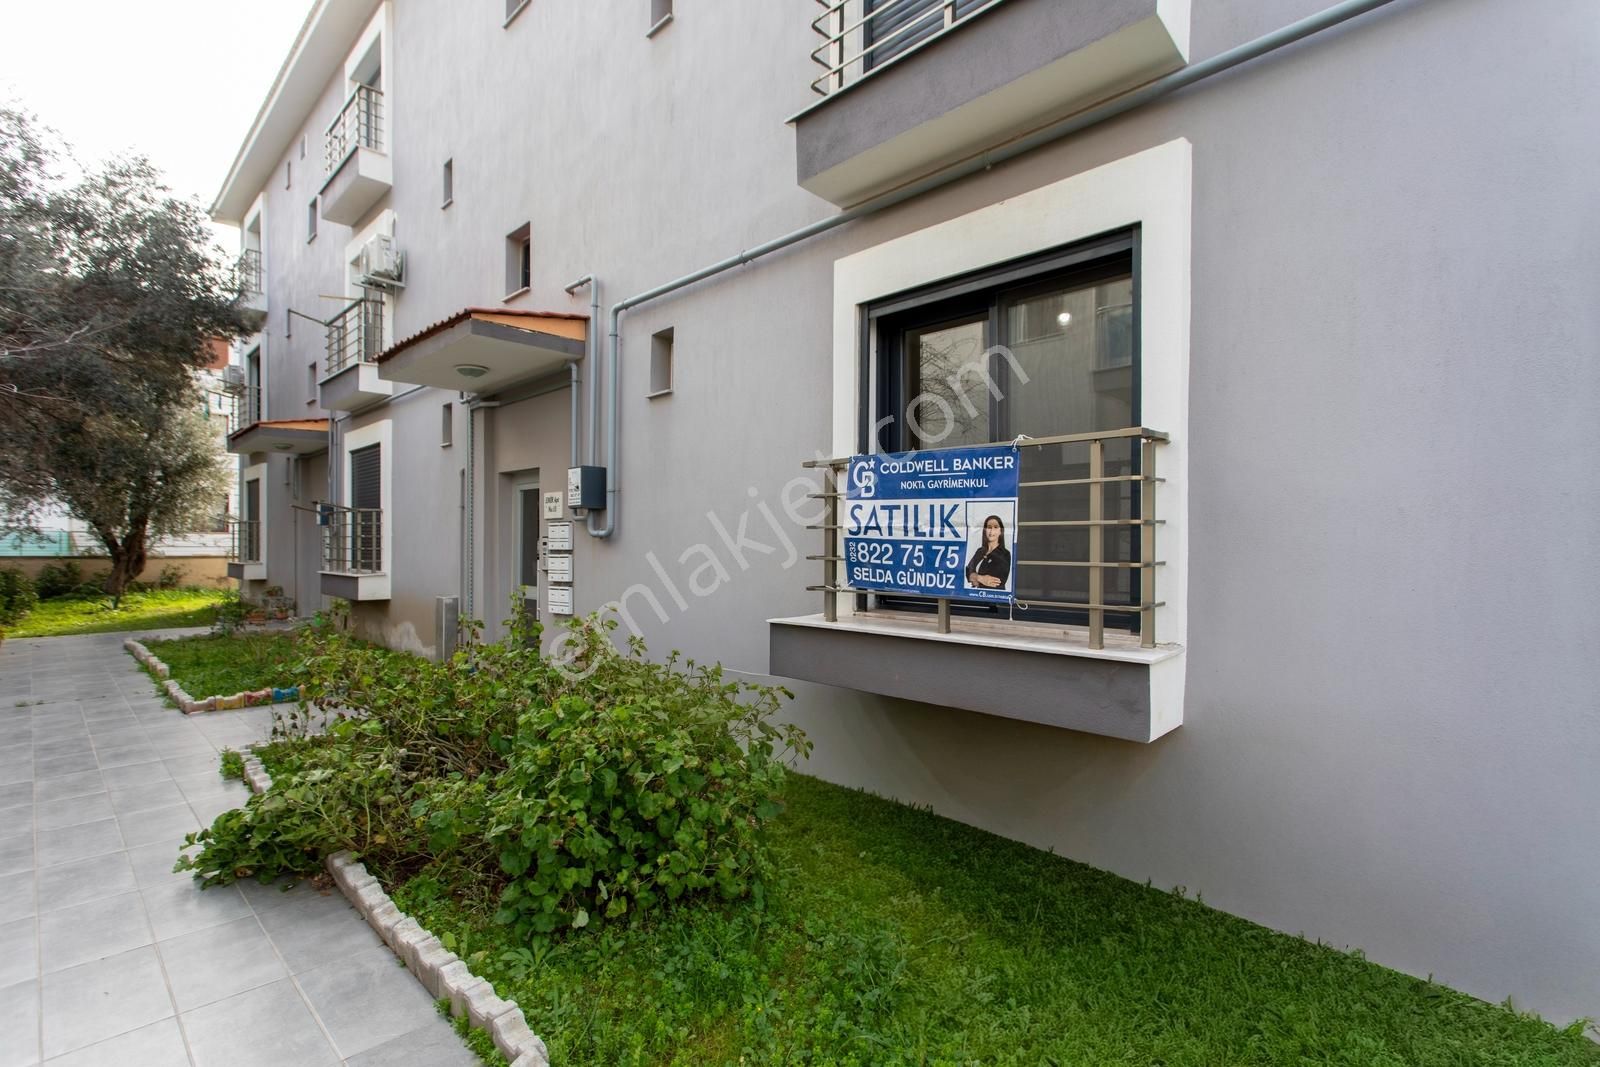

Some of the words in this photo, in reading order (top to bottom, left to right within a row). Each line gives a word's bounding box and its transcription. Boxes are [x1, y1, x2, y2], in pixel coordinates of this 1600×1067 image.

[880, 460, 948, 474] COLDWELL
[953, 456, 1014, 471] BANKER
[900, 480, 926, 490] NOKTA
[927, 477, 989, 489] GAYRİMENKUL
[848, 503, 961, 539] SATILIK
[857, 542, 894, 565] 822
[900, 544, 925, 567] 75
[932, 546, 960, 569] 75
[853, 567, 894, 584] SELDA
[896, 569, 956, 589] GÜNDÜZ
